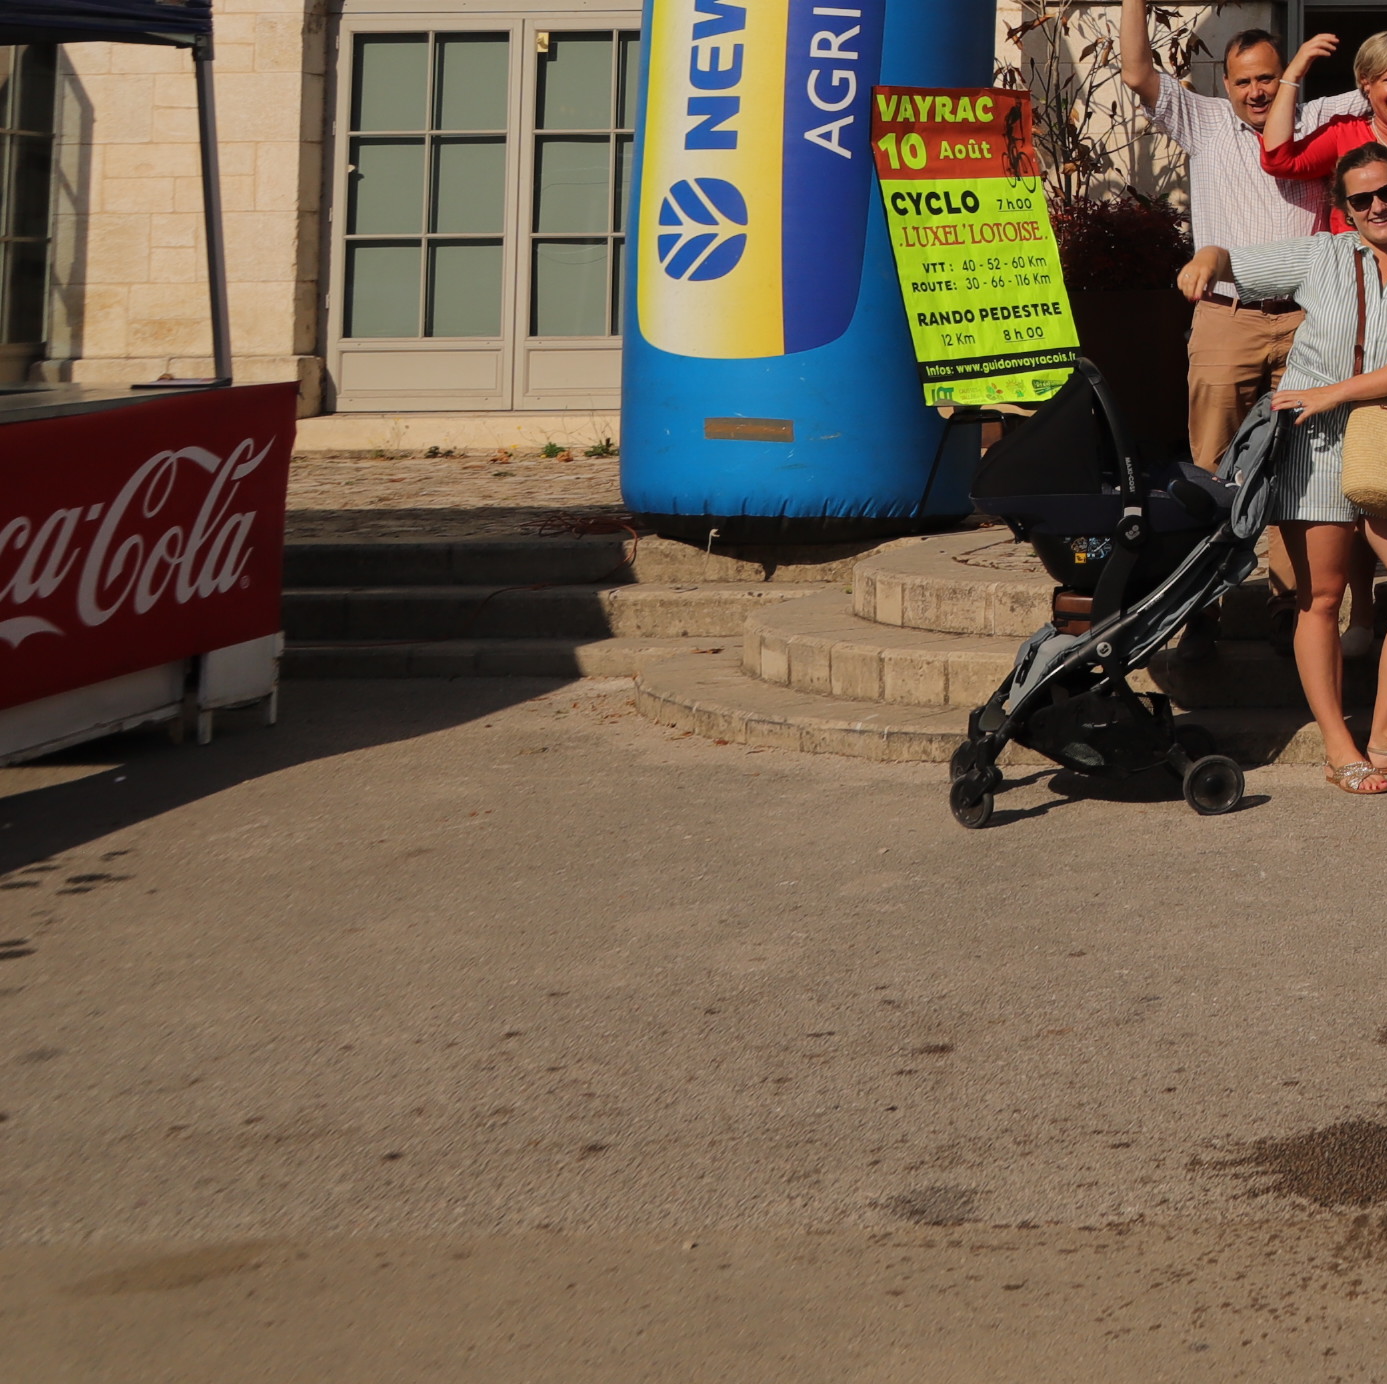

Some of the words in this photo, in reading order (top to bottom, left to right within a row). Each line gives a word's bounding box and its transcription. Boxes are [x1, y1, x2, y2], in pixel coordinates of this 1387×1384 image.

[876, 94, 994, 123] VAYRAC
[877, 133, 927, 170] 10
[939, 139, 992, 160] Août
[891, 190, 980, 216] CYCLO
[962, 259, 976, 271] 40
[987, 258, 1000, 270] 52
[1011, 257, 1025, 269] 60
[1028, 256, 1047, 267] Km
[911, 280, 958, 293] ROUTE:
[966, 277, 980, 290] 30
[991, 276, 1005, 288] 66
[1015, 274, 1030, 286] 116
[1033, 273, 1051, 284] Km
[917, 309, 975, 327] RANDO
[979, 301, 1062, 322] PEDESTRE
[941, 333, 953, 346] 12
[956, 333, 976, 345] Km
[925, 364, 954, 376] Infos:
[956, 351, 1076, 373] www.guidonvayracois.fr
[1125, 457, 1136, 492] MAXI-COSI
